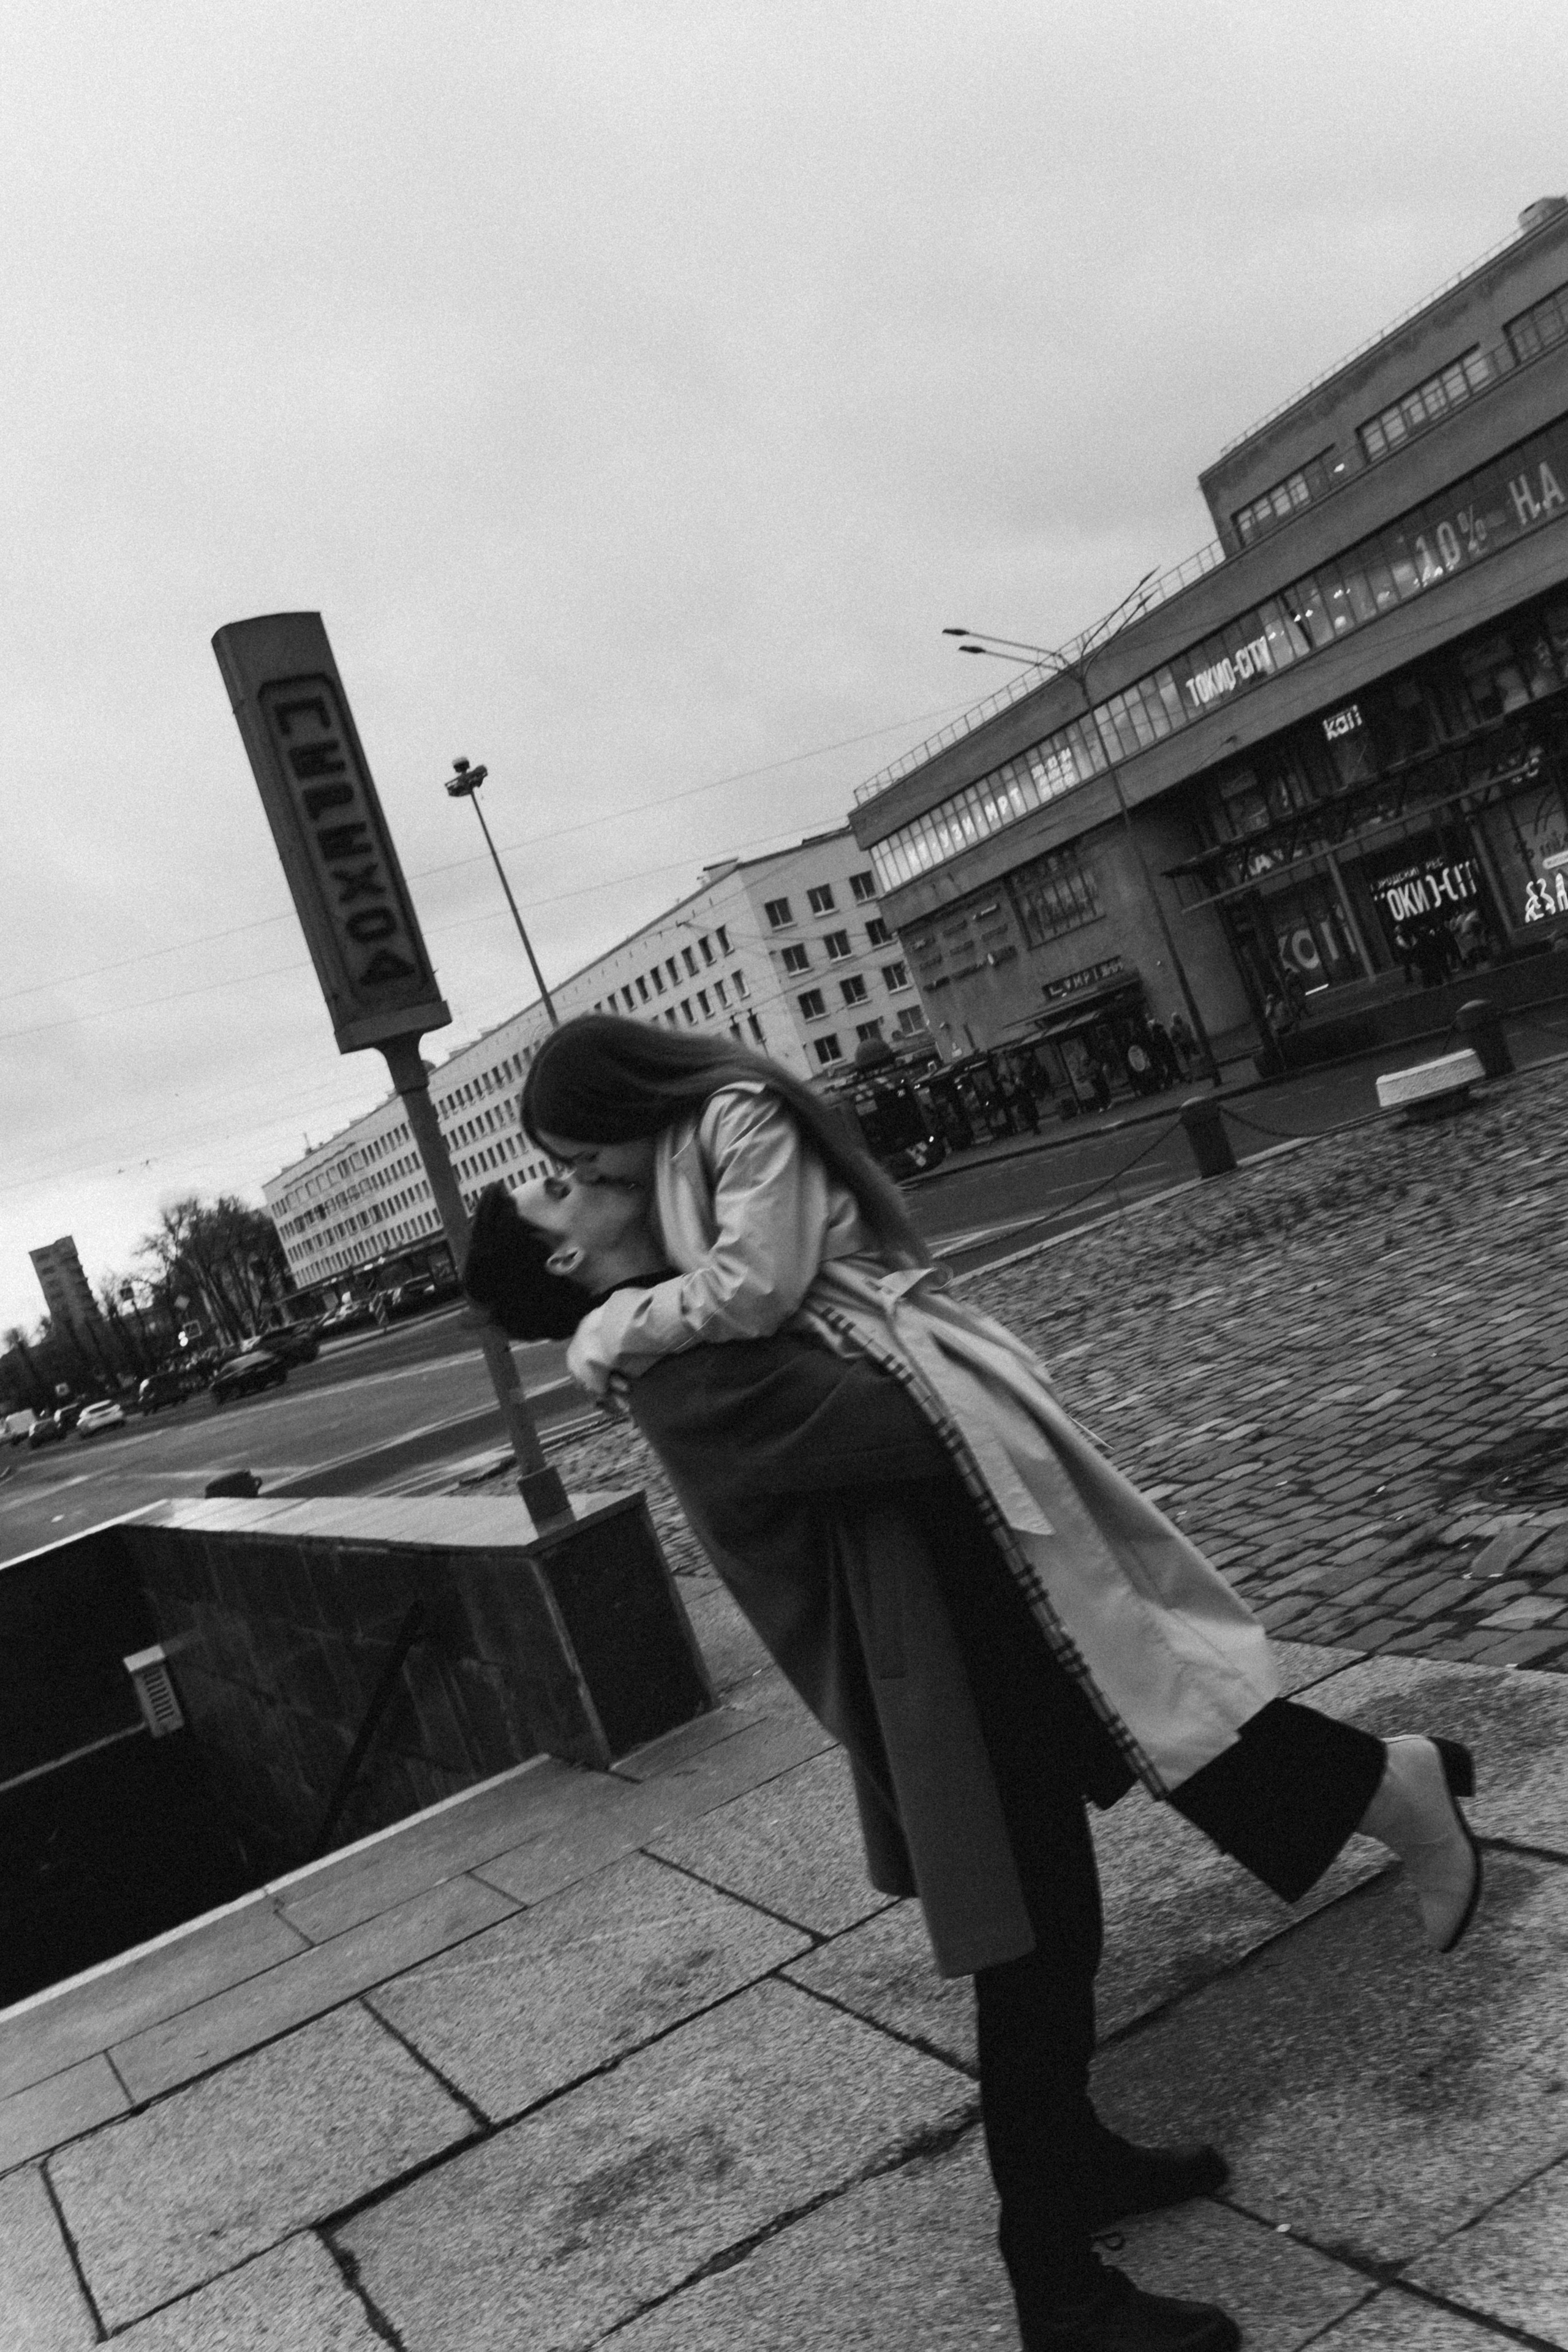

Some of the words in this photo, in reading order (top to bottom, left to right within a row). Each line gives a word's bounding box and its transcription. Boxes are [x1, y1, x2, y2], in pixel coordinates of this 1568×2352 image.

[1509, 461, 1566, 525] НА
[1322, 704, 1362, 741] kari
[274, 695, 417, 986] ПЕРЕХОД
[939, 816, 975, 848] УЗИ
[984, 787, 1021, 823] МРТ
